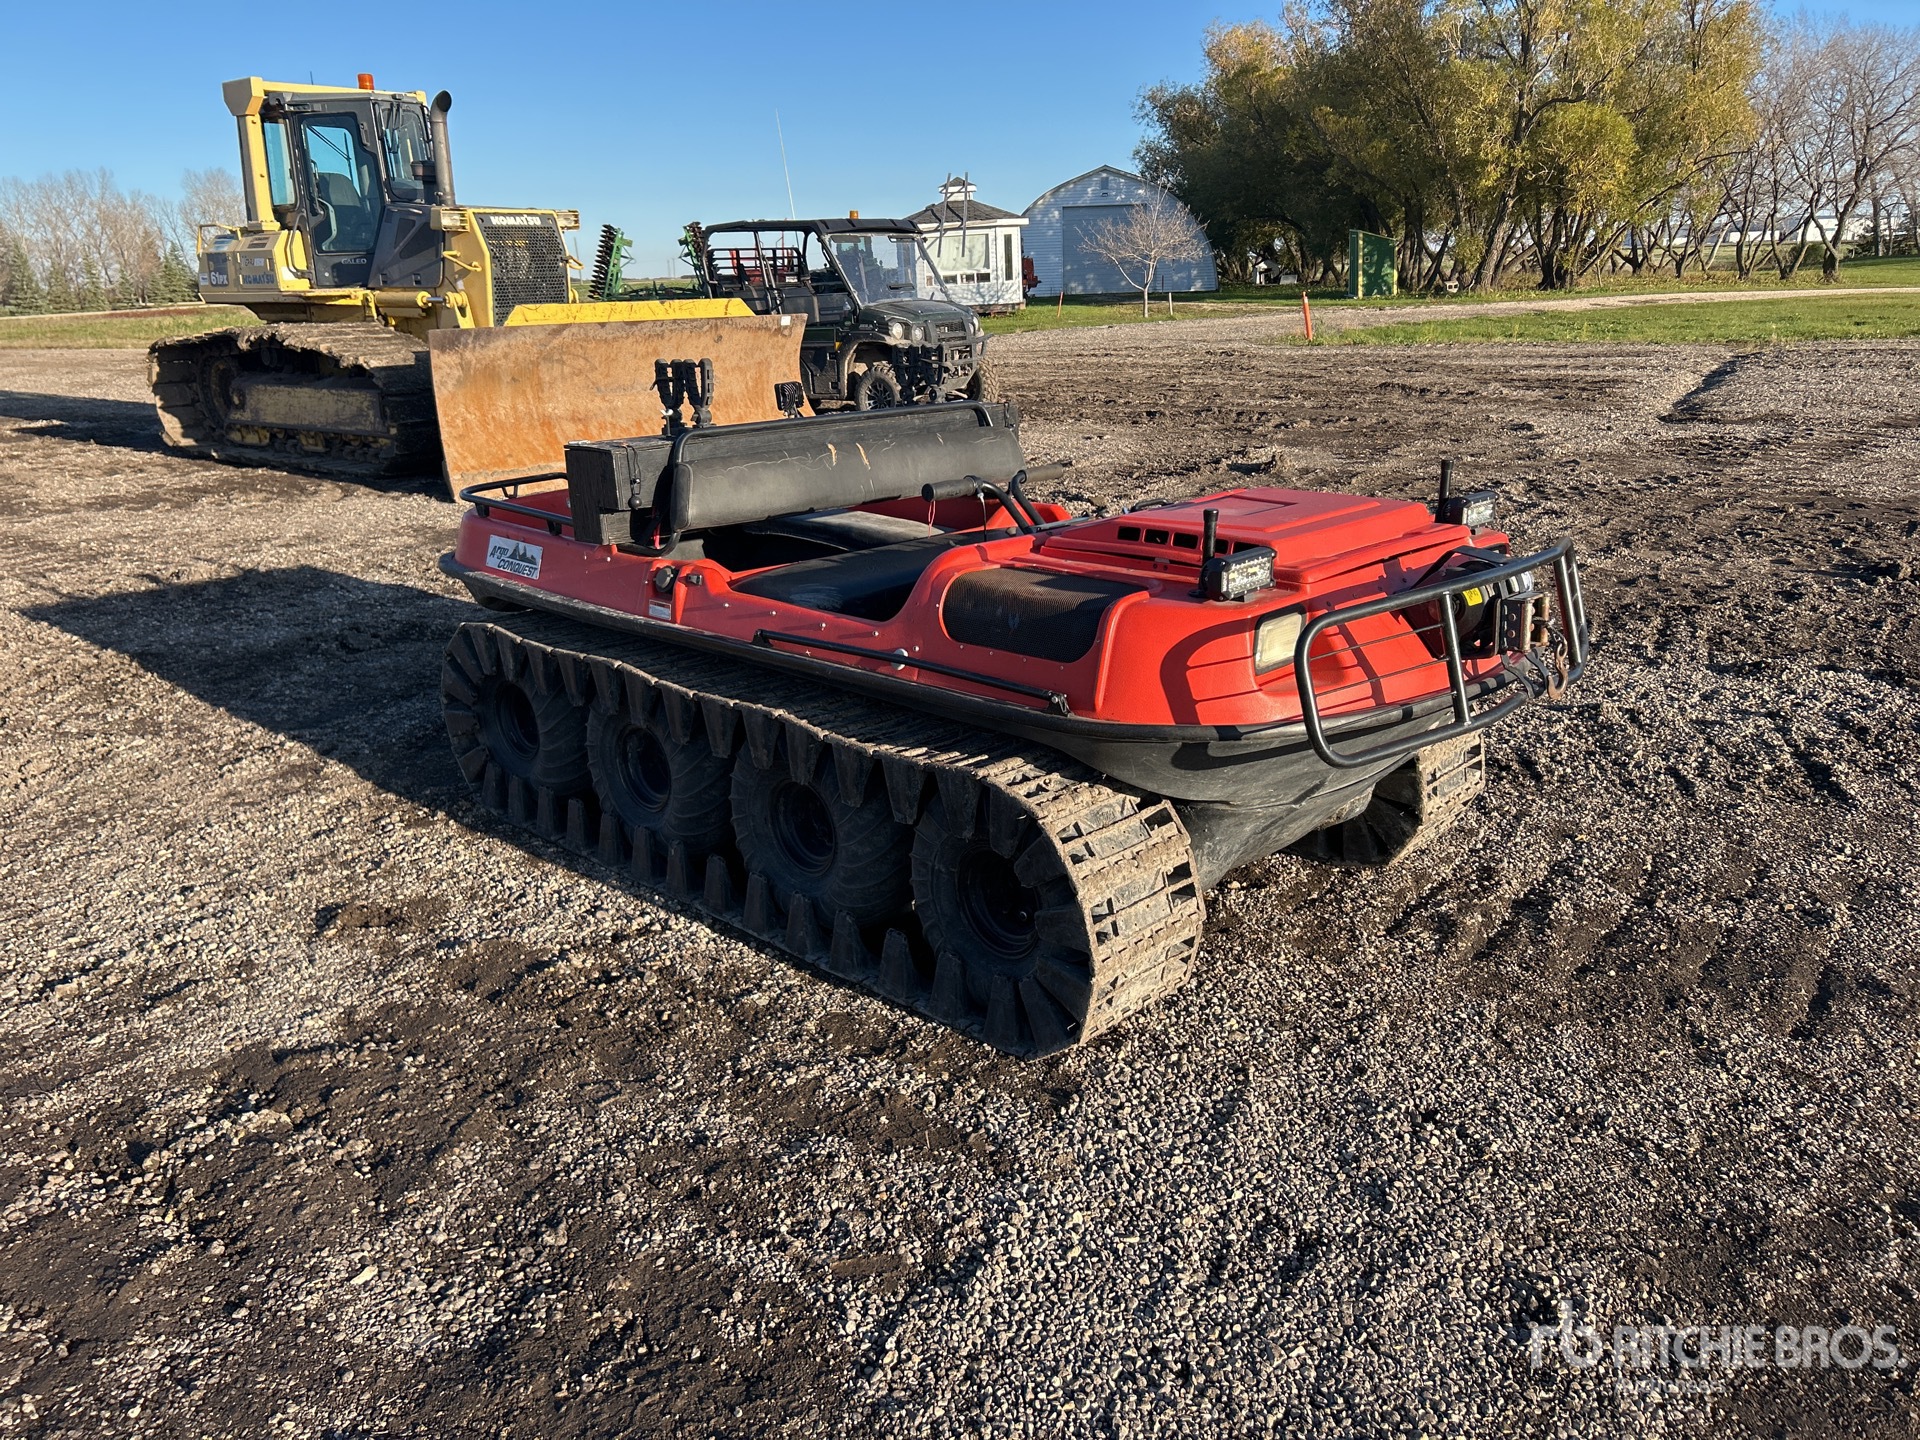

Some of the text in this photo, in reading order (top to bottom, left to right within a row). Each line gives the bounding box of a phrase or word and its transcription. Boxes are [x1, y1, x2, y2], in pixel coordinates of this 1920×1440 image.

[490, 214, 541, 226] KOMATSU
[243, 272, 275, 284] KOMATSU
[497, 559, 538, 577] CONQUEST
